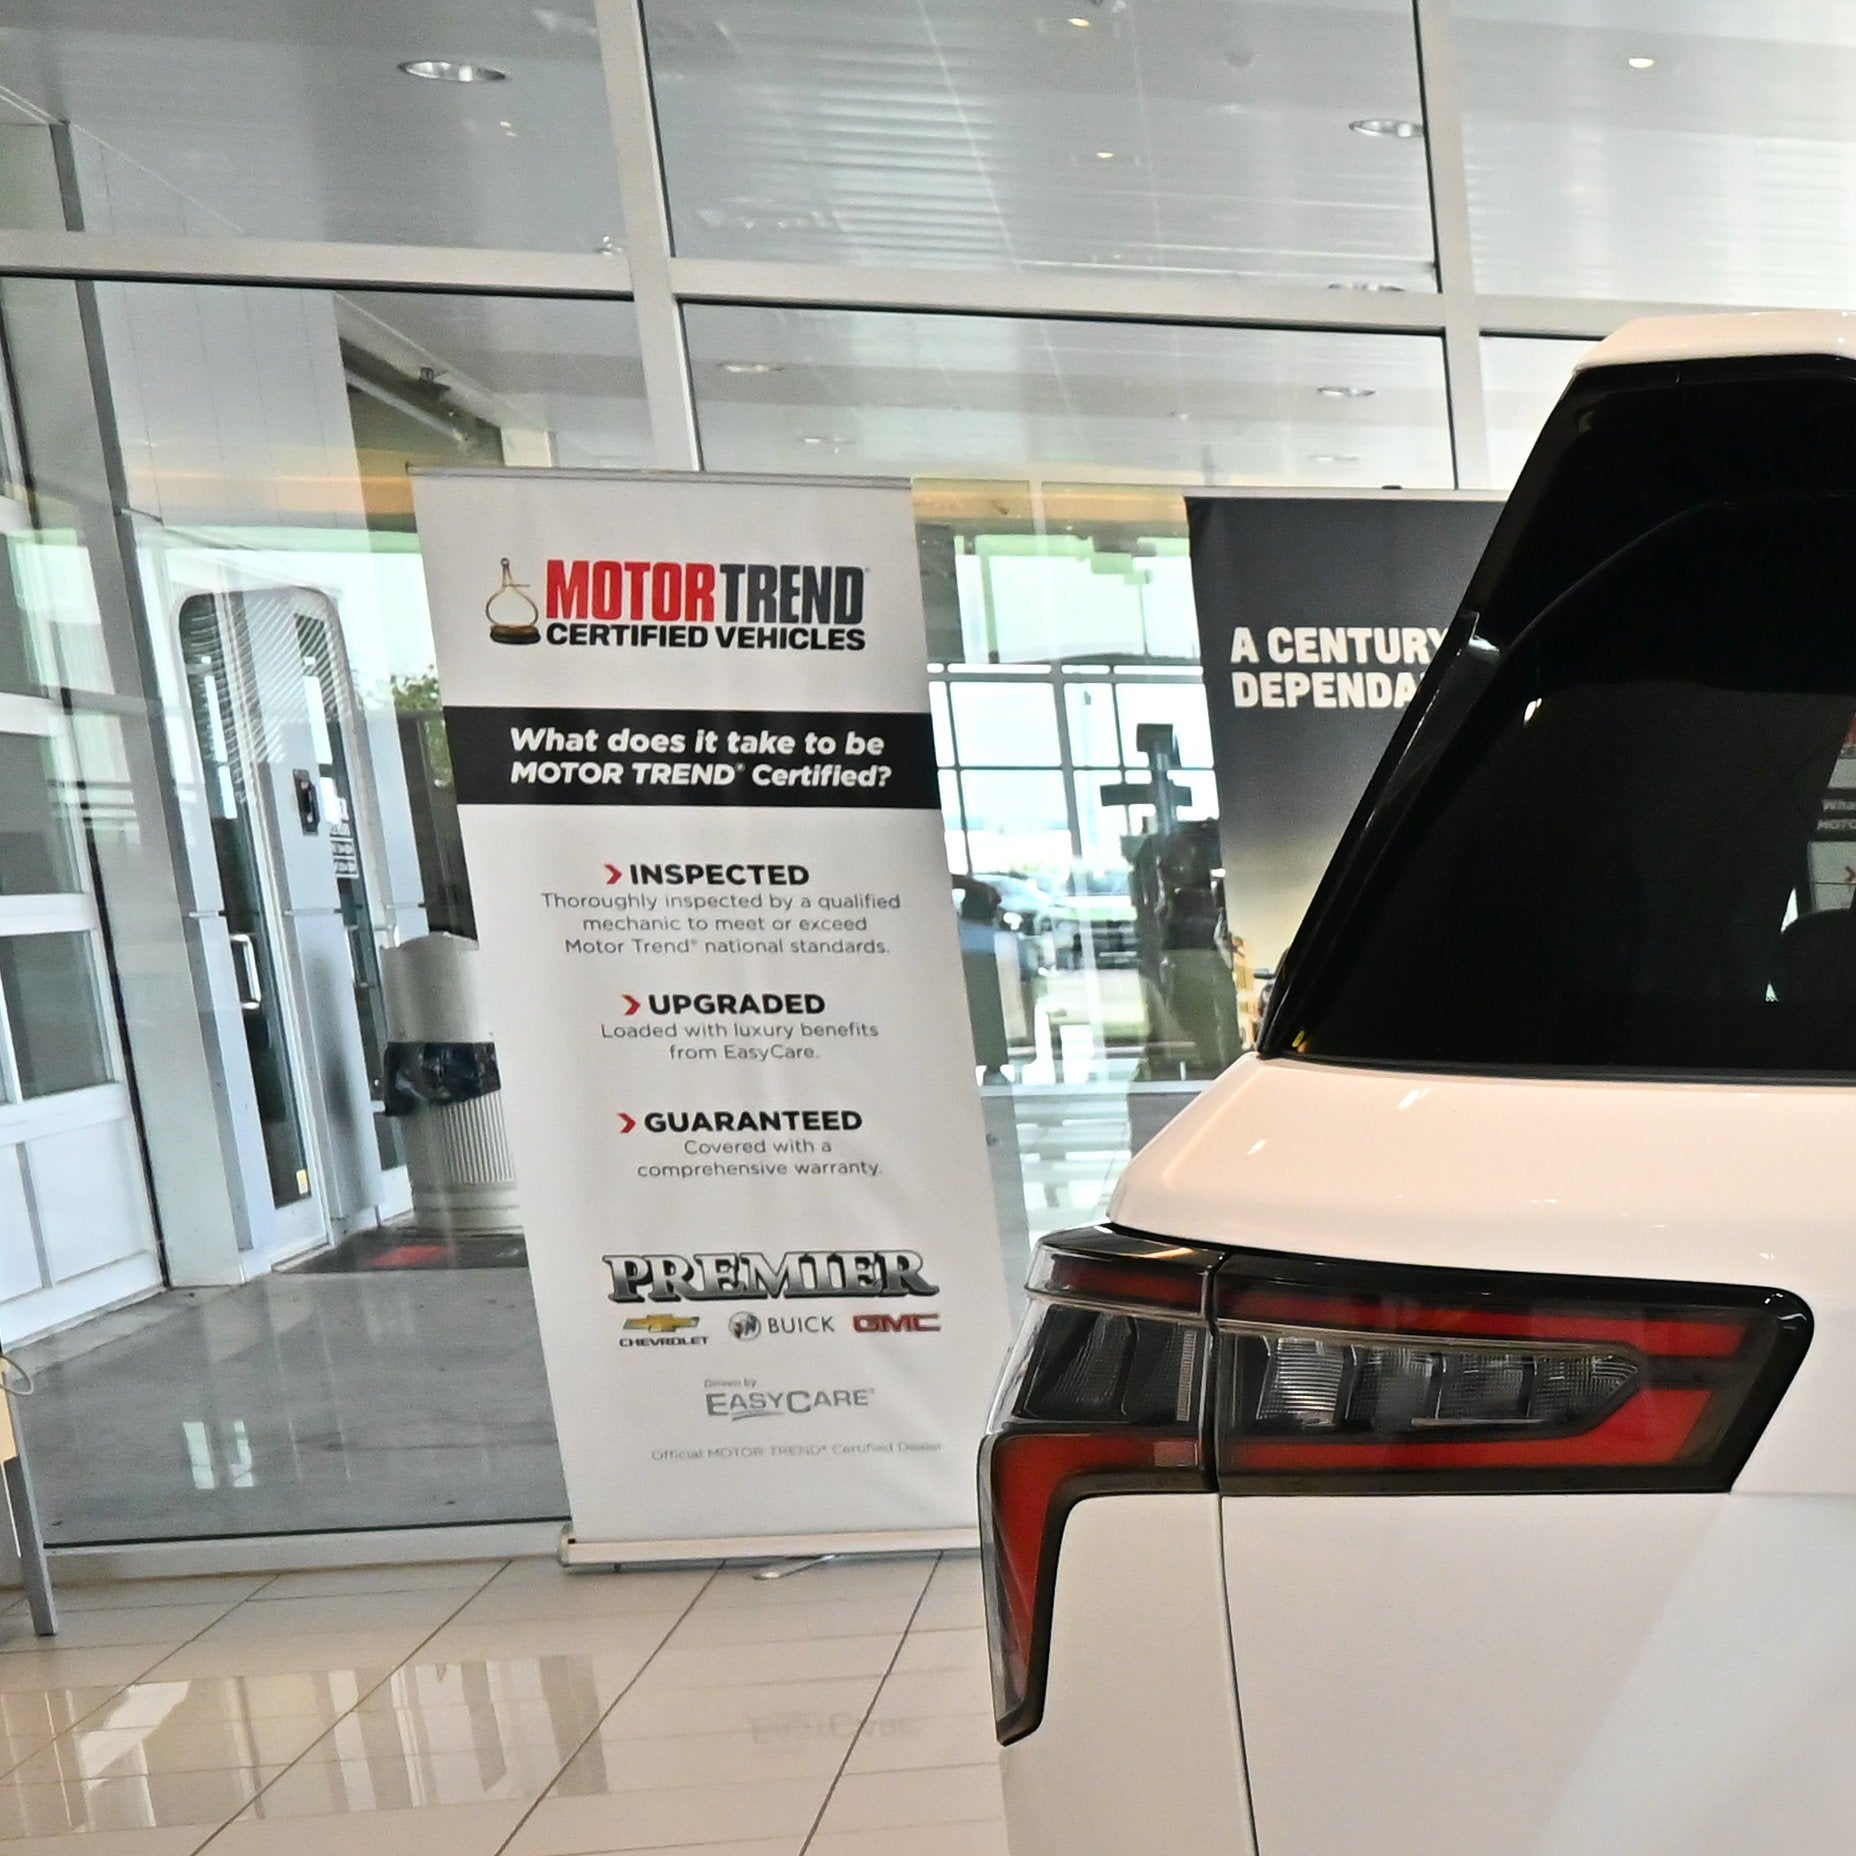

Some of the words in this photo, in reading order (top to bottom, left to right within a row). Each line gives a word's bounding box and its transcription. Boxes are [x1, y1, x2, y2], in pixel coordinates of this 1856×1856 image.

[547, 622, 708, 648] CERTIFIED
[716, 626, 866, 651] VEHICLES
[1230, 627, 1259, 664] A
[1231, 671, 1425, 709] DEPENDA
[510, 727, 598, 752] What
[607, 728, 686, 752] does
[695, 729, 718, 752] it
[727, 730, 796, 754] take
[805, 731, 837, 755] to
[845, 731, 885, 756] be
[511, 761, 624, 785] MOTOR
[751, 764, 892, 788] Certified?
[630, 864, 810, 886] INSPECTED
[541, 892, 658, 912] Thoroughly
[665, 893, 763, 912] inspected
[770, 893, 793, 910] by
[801, 896, 811, 909] a
[818, 894, 901, 912] qualified
[583, 916, 680, 932] mechanic
[688, 917, 708, 932] to
[715, 917, 765, 932] meet
[772, 919, 792, 932] or
[799, 916, 867, 932] exceed
[565, 939, 624, 954] Motor
[704, 939, 783, 954] national
[790, 939, 890, 955] standards.
[648, 994, 826, 1015] UPGRADED
[600, 1022, 677, 1039] Loaded
[684, 1022, 727, 1038] with
[734, 1022, 793, 1041] luxury
[800, 1021, 878, 1038] benefits
[669, 1044, 717, 1061] from
[724, 1044, 819, 1063] EasyCare.
[644, 1110, 862, 1133] GUARANTEED
[684, 1139, 766, 1156] Covered
[772, 1138, 814, 1154] with
[821, 1142, 832, 1153] a
[637, 1161, 788, 1179] comprehensive
[795, 1160, 882, 1178] warranty.
[602, 1250, 940, 1303] PREMIER
[768, 1315, 836, 1335] BUICK
[853, 1313, 941, 1333] GMC
[619, 1336, 709, 1347] CHEVROLET
[707, 1447, 763, 1459] MOTOR
